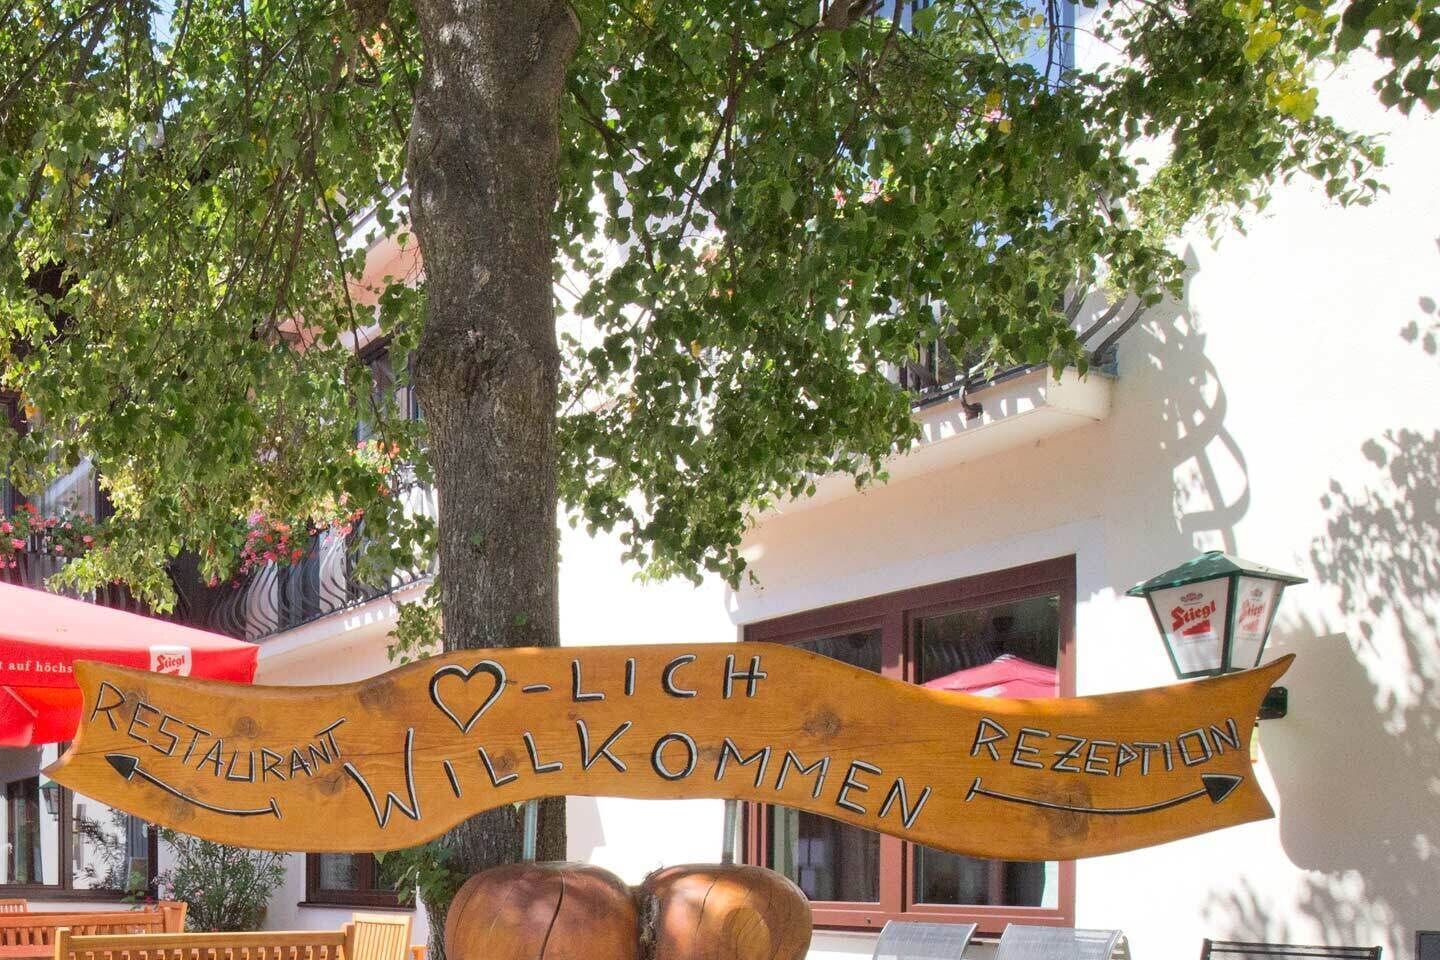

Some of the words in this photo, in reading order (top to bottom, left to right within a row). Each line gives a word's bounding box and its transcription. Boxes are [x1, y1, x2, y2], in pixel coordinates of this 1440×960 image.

[1171, 600, 1216, 632] Stiegl
[10, 659, 31, 672] auf
[156, 654, 185, 673] Stiegl
[90, 678, 347, 783] RESTAURANT
[969, 717, 1241, 777] REZEPTION
[343, 719, 932, 829] WILLKOMMEN
